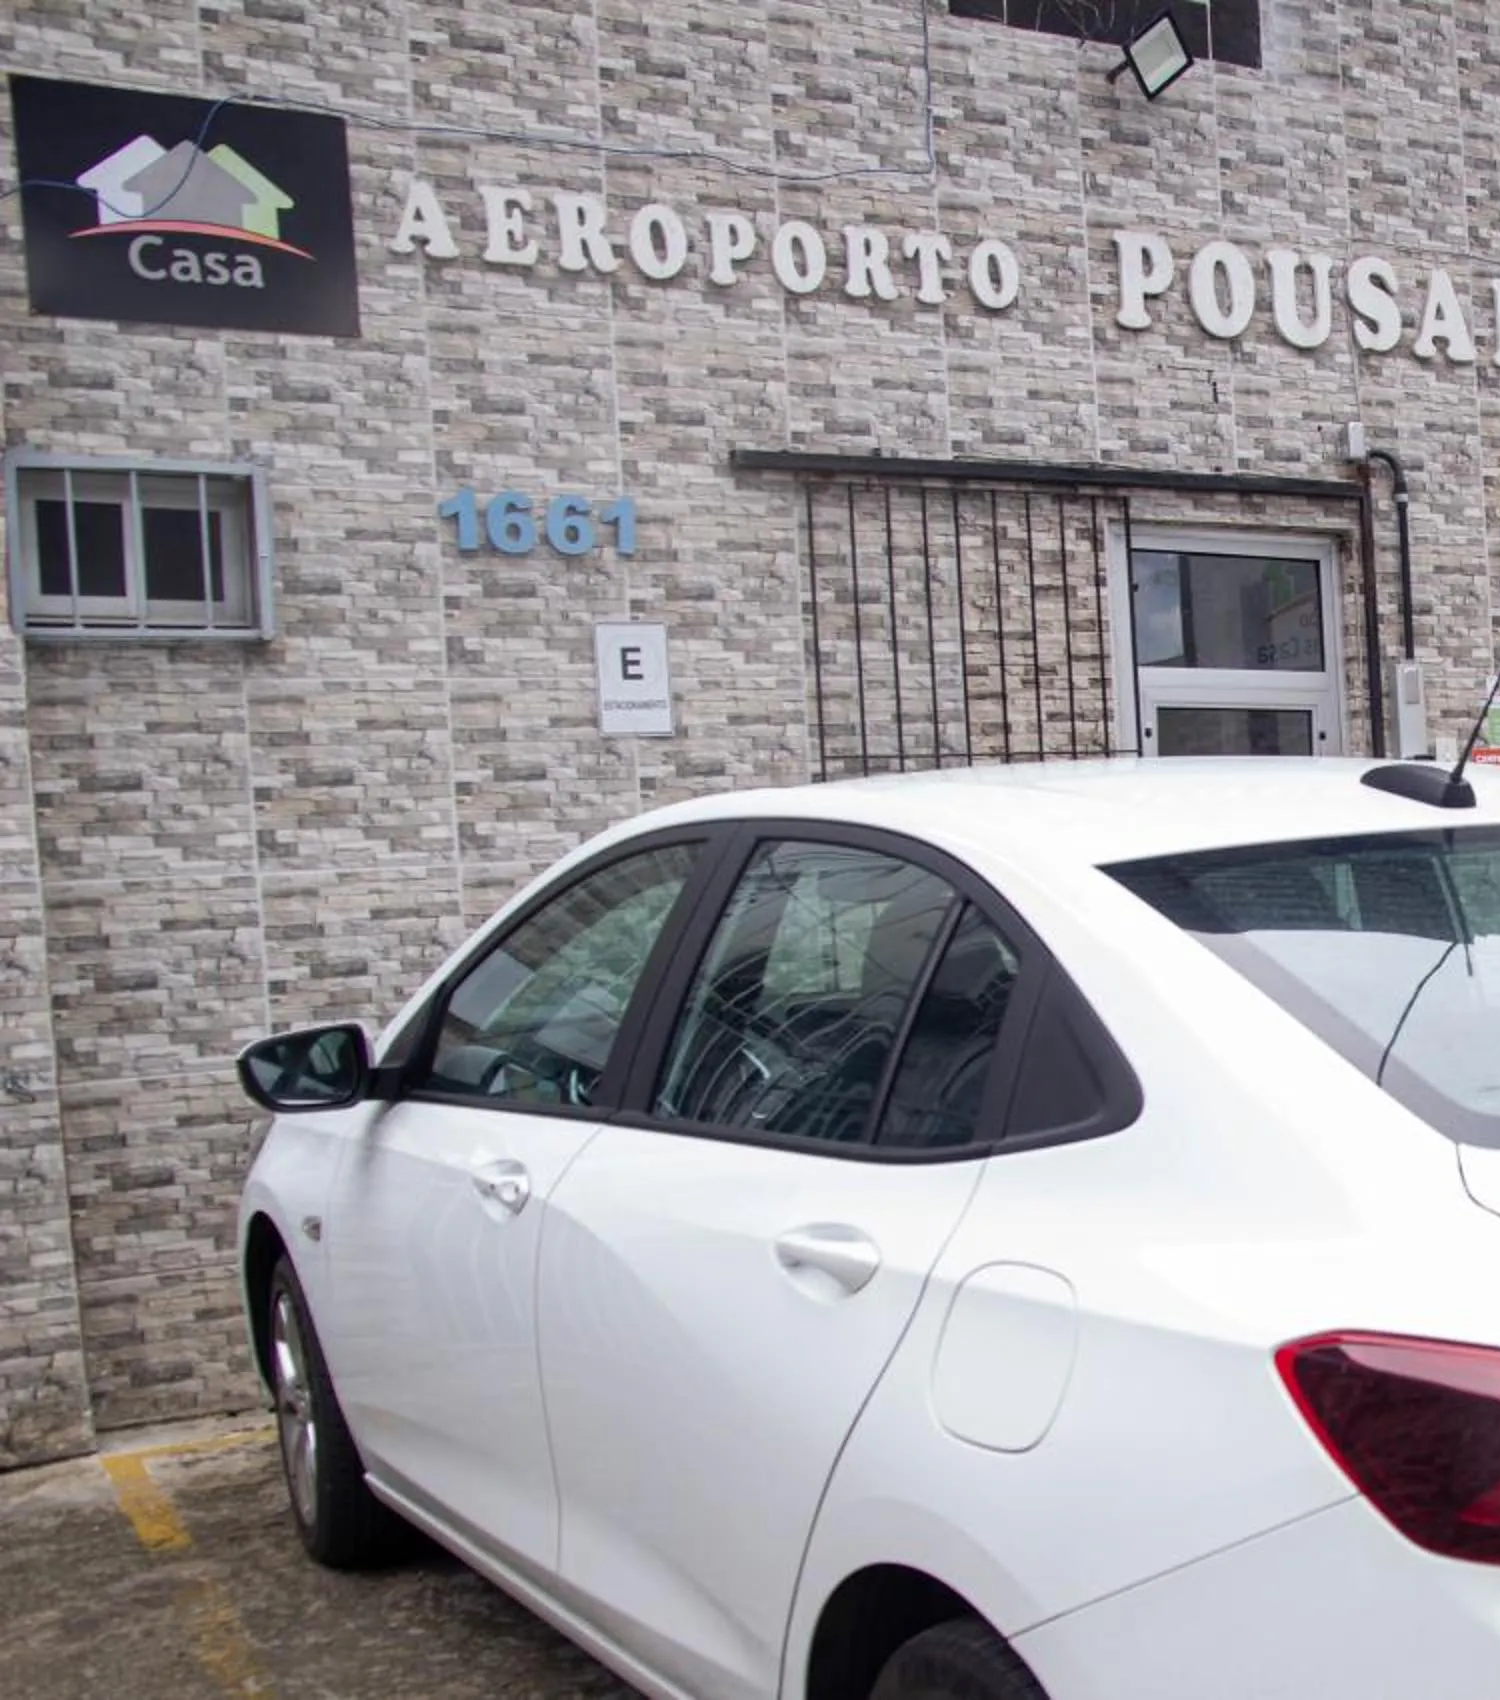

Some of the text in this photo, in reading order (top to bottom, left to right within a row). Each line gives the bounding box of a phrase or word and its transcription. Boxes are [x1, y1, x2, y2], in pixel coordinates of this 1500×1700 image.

[127, 234, 265, 289] Casa
[390, 179, 1020, 310] AEROPORTO
[438, 486, 637, 557] 1661
[620, 647, 643, 681] E
